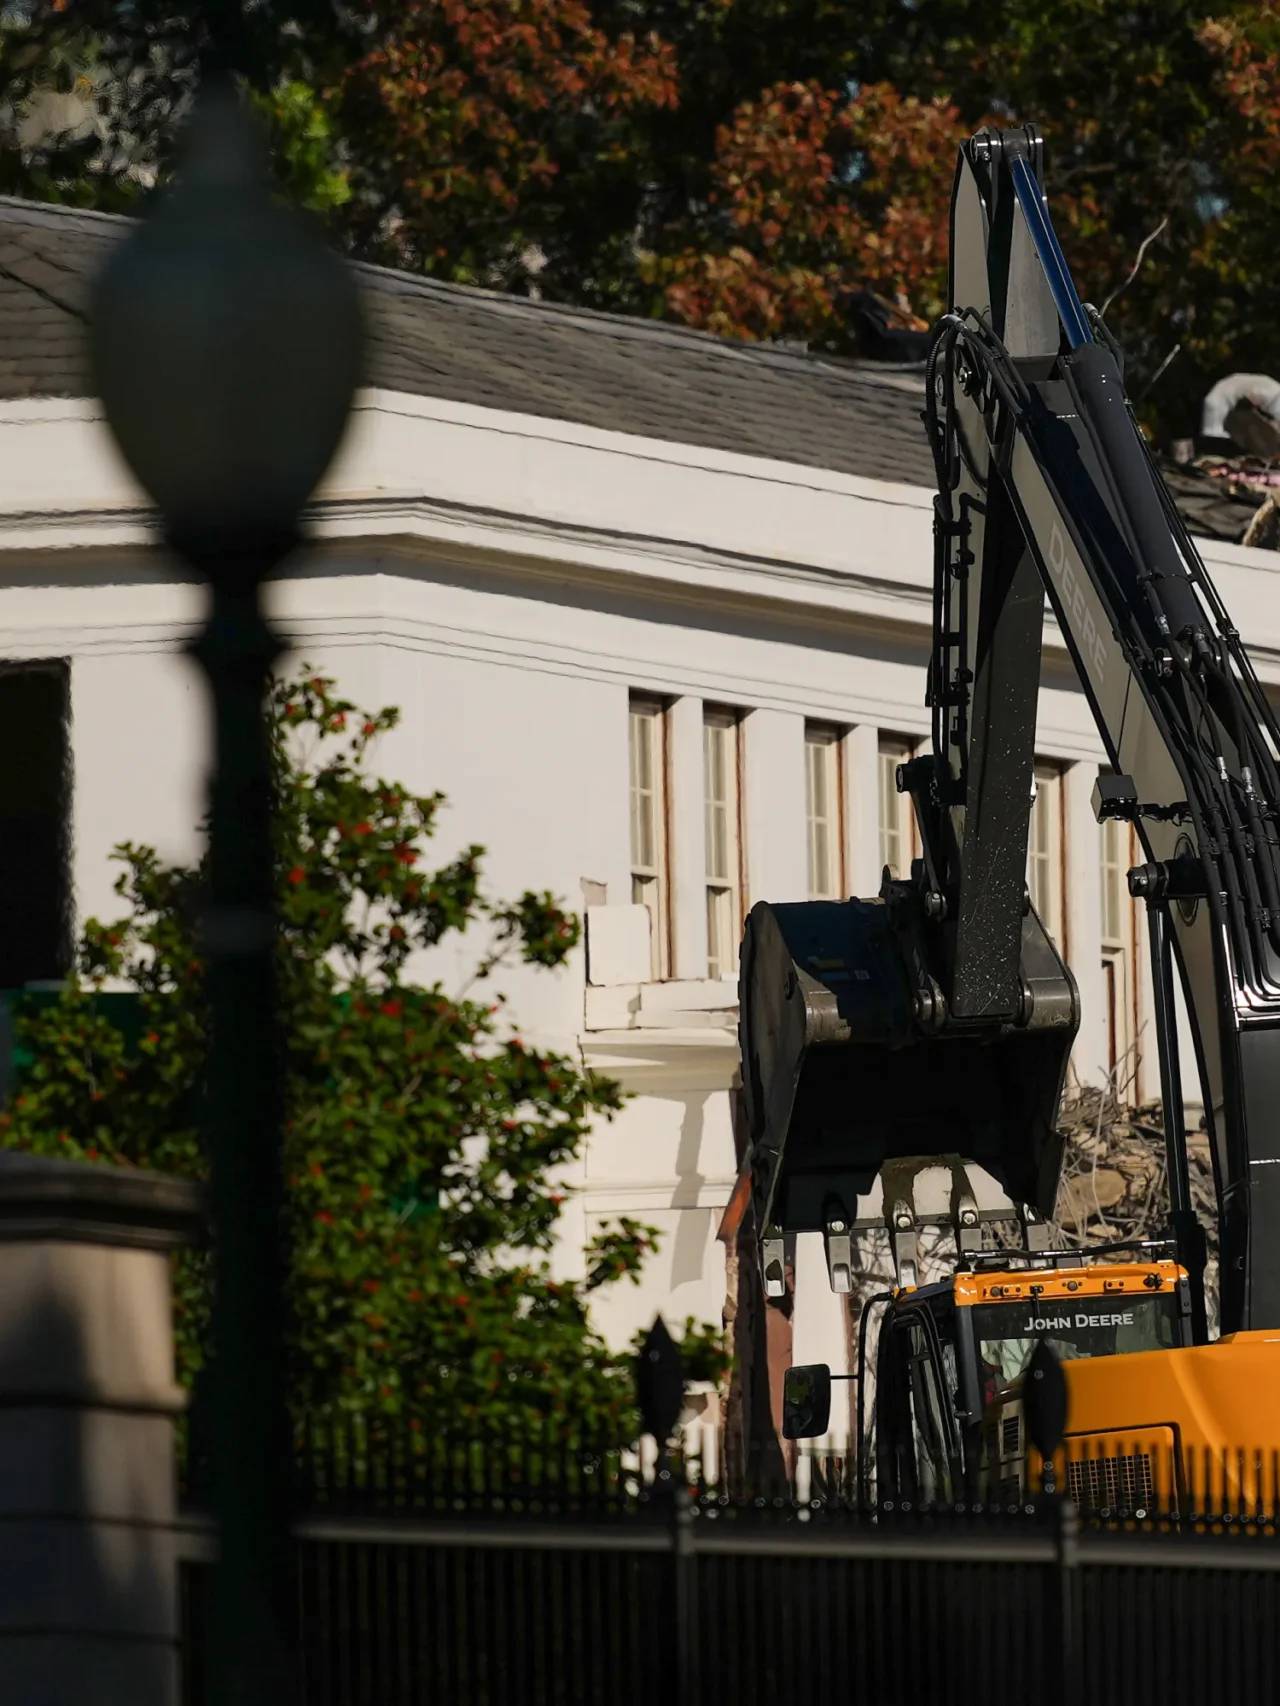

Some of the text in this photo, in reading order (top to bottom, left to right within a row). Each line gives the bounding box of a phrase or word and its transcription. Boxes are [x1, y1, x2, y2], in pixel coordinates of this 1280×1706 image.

[1051, 521, 1107, 683] DEERE
[1024, 1313, 1134, 1331] JOHN DEERE
